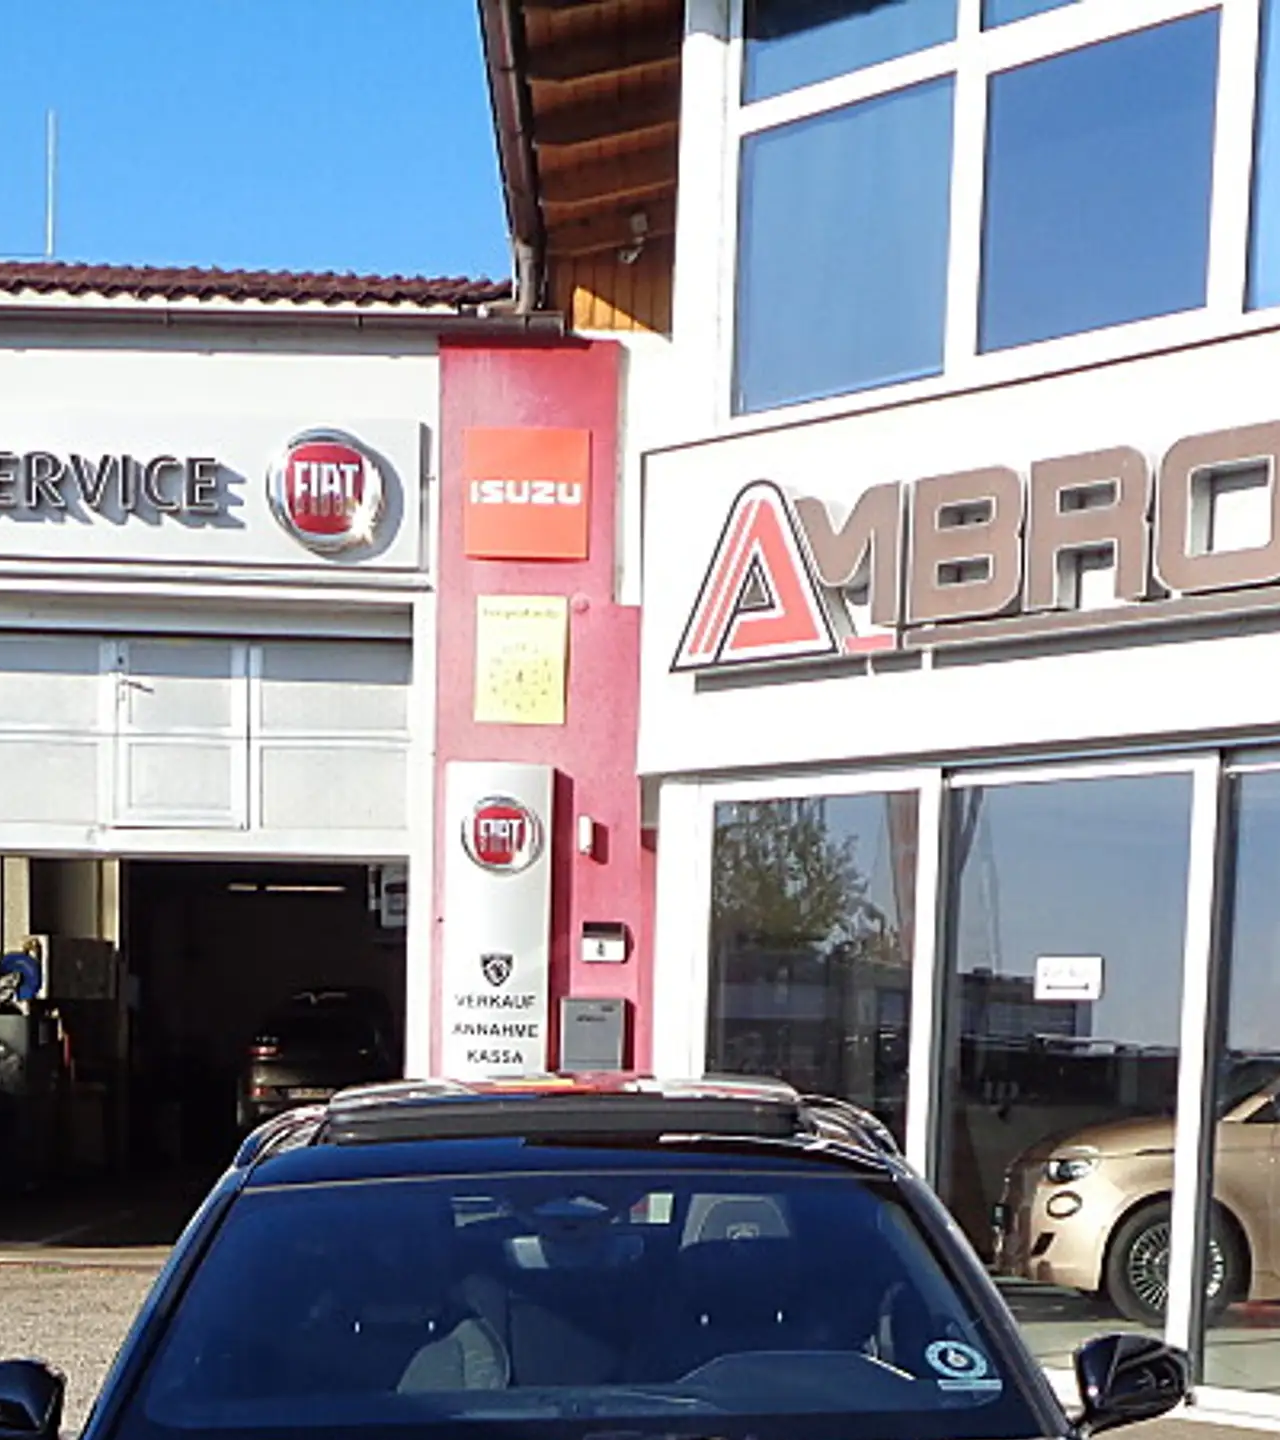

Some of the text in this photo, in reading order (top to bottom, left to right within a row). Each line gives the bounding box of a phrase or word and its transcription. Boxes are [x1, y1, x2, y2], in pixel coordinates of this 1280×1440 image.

[293, 461, 360, 499] FIAT
[470, 479, 582, 505] ISUZU
[480, 819, 524, 852] FIAT
[455, 994, 536, 1009] VERKAUF
[452, 1023, 540, 1038] ANNAHME
[467, 1049, 523, 1064] KASSA
